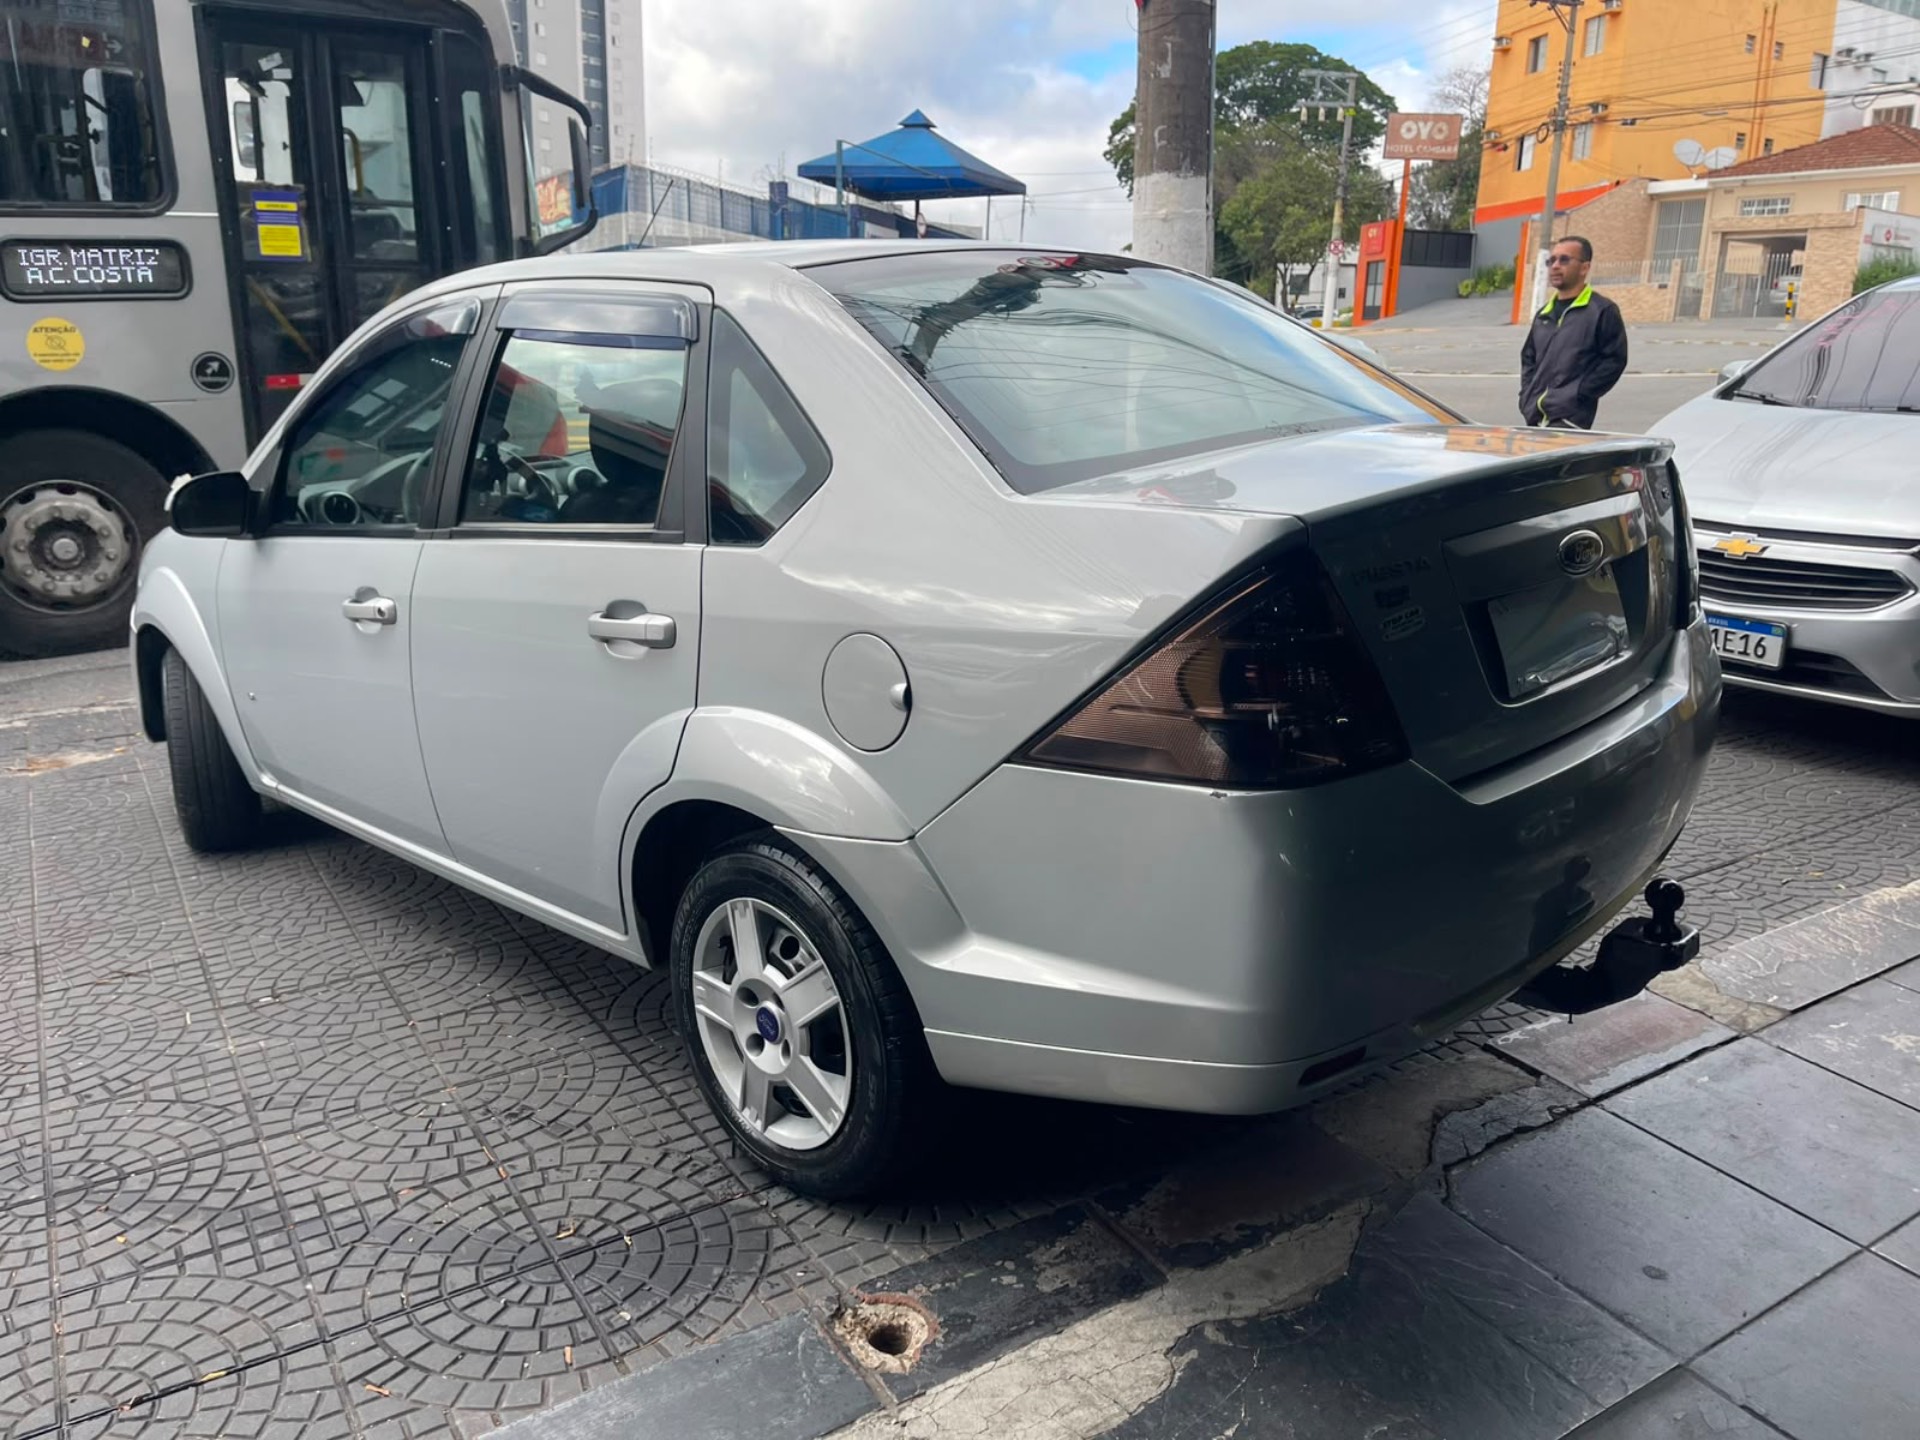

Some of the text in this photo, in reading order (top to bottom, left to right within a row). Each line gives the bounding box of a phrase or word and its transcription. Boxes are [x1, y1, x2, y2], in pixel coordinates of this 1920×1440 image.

[1400, 120, 1449, 140] OYO
[1386, 143, 1414, 153] HOTEL
[32, 325, 77, 334] ATENÇÃO
